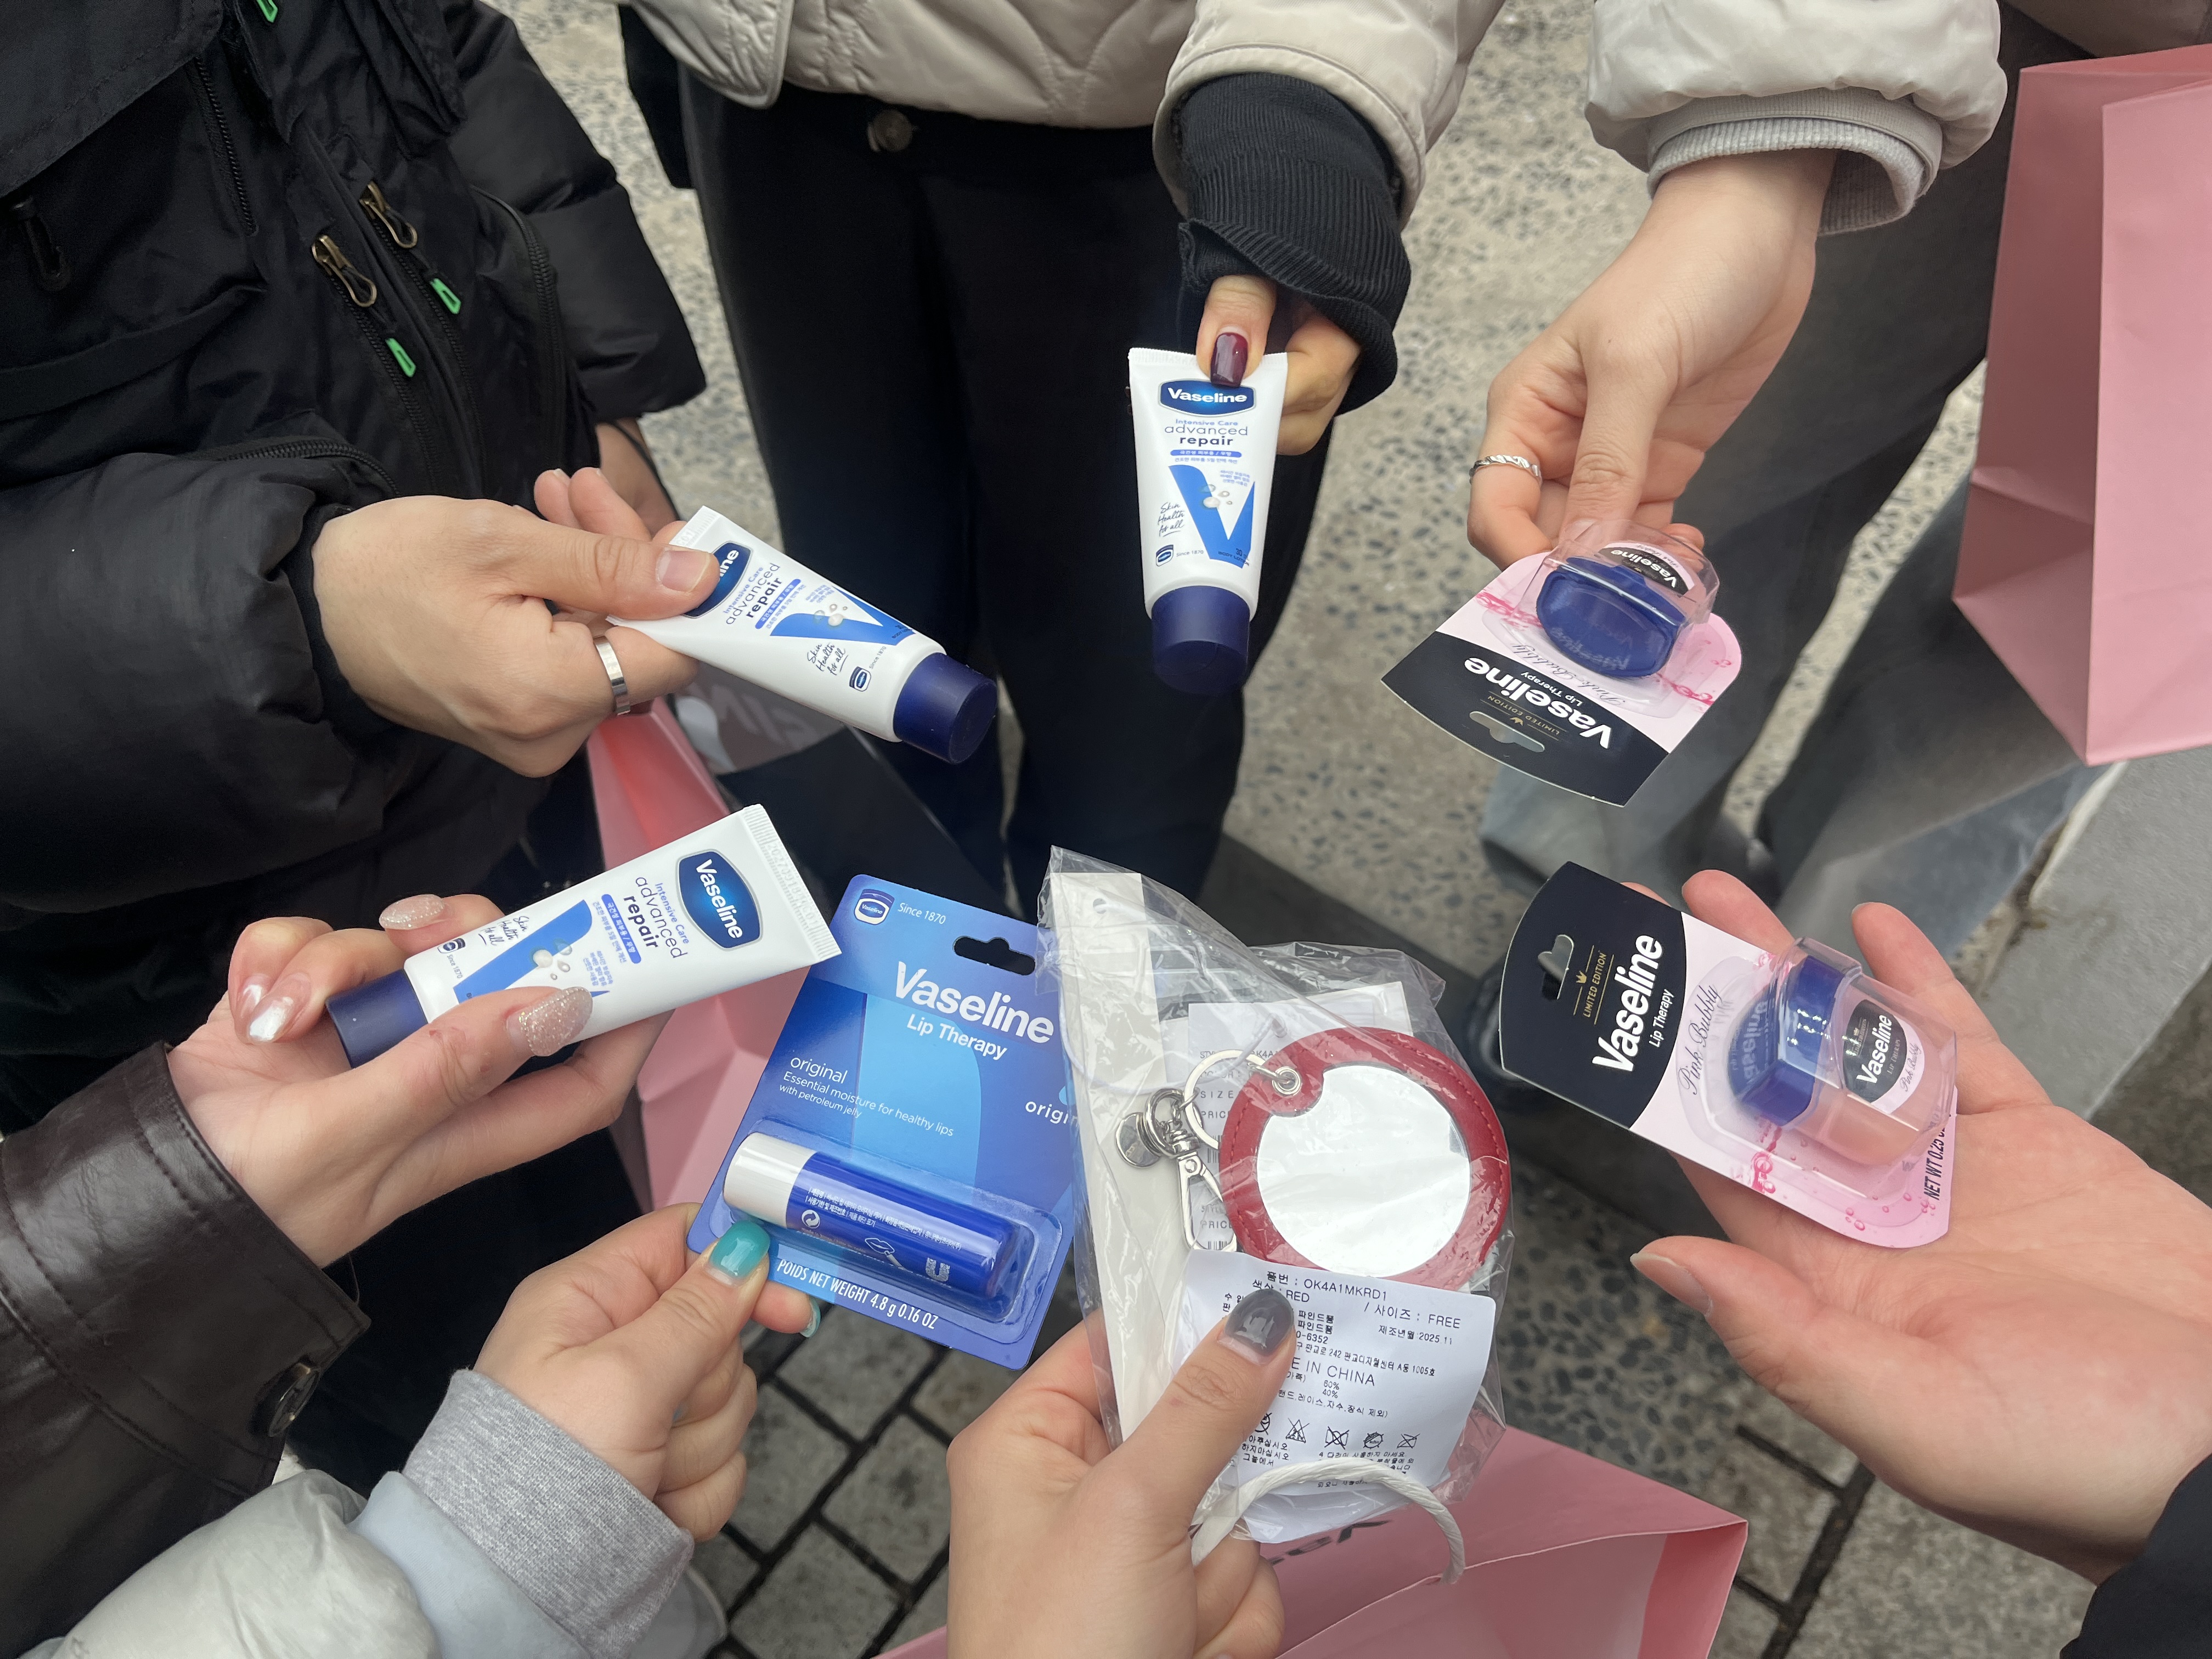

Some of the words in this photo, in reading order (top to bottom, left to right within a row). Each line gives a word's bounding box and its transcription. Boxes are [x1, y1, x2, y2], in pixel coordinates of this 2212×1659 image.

[1168, 388, 1247, 403] Vaseline
[1165, 424, 1248, 436] advanced
[1180, 436, 1233, 447] repair
[1158, 510, 1185, 525] Health
[1160, 502, 1180, 514] Skin
[1611, 550, 1677, 588] Vaseline
[723, 584, 749, 613] Intensive
[748, 567, 763, 583] Care
[726, 562, 781, 624] advanced
[746, 578, 782, 618] repair
[807, 644, 822, 664] Skin
[816, 642, 835, 672] Health
[827, 663, 837, 675] for
[836, 648, 846, 663] all
[869, 657, 879, 669] Since
[877, 646, 887, 656] 1870
[1520, 671, 1564, 698] Therapy
[1464, 657, 1612, 749] Vaseline
[1487, 695, 1524, 716] EDITION
[1565, 693, 1584, 707] Lip
[1525, 715, 1561, 736] LIMITED
[696, 859, 743, 939] Vaseline
[862, 904, 883, 915] Vaseline
[513, 916, 529, 932] Skin
[624, 896, 658, 947] repair
[636, 877, 688, 958] advanced
[655, 883, 678, 923] Intensive
[675, 924, 689, 944] Care
[898, 902, 922, 917] Since
[924, 911, 946, 924] 1870
[488, 934, 505, 946] all
[497, 920, 518, 940] Health
[447, 955, 456, 966] Since
[453, 966, 463, 978] 1870
[1583, 986, 1598, 1018] LIMITED
[1592, 952, 1607, 985] EDITION
[895, 961, 1054, 1043] Vaseline
[1592, 935, 1663, 1071] Vaseline
[1652, 989, 1675, 1029] Therapy
[1689, 985, 1722, 1048] Bubbly
[907, 1013, 934, 1037] Lip
[939, 1023, 1008, 1060] Therapy
[1649, 1031, 1664, 1047] Lip
[1857, 1015, 1892, 1083] Vaseline
[790, 1057, 848, 1084] original
[1679, 1046, 1704, 1094] Pink
[1899, 1068, 1914, 1092] Pink
[780, 1085, 798, 1096] with
[798, 1091, 843, 1111] petroleum
[843, 1105, 862, 1119] jelly
[783, 1071, 830, 1094] Essential
[831, 1088, 876, 1110] moisture
[878, 1103, 894, 1116] for
[895, 1108, 934, 1131] healthy
[935, 1122, 953, 1136] lips
[1926, 1157, 1942, 1178] WT
[1923, 1176, 1941, 1200] NET
[777, 1259, 809, 1280] POIDS
[809, 1270, 831, 1288] NET
[830, 1278, 871, 1304] WEIGHT
[870, 1294, 889, 1311] 4.8
[887, 1304, 897, 1317] g
[898, 1303, 922, 1323] 0.16
[922, 1313, 939, 1329] OZ
[1267, 1271, 1289, 1285] 품번
[1304, 1278, 1387, 1301] OK4A1MKRD1
[1286, 1290, 1310, 1302] RED
[1374, 1305, 1410, 1320] 사이즈
[1429, 1314, 1461, 1328] FREE
[1306, 1344, 1327, 1356] 판교로
[1329, 1348, 1342, 1358] 242
[1413, 1365, 1435, 1376] 1005호
[1306, 1360, 1321, 1374] IN
[1327, 1365, 1375, 1386] CHINA
[1322, 1389, 1338, 1398] 40%
[1323, 1380, 1340, 1390] 60%
